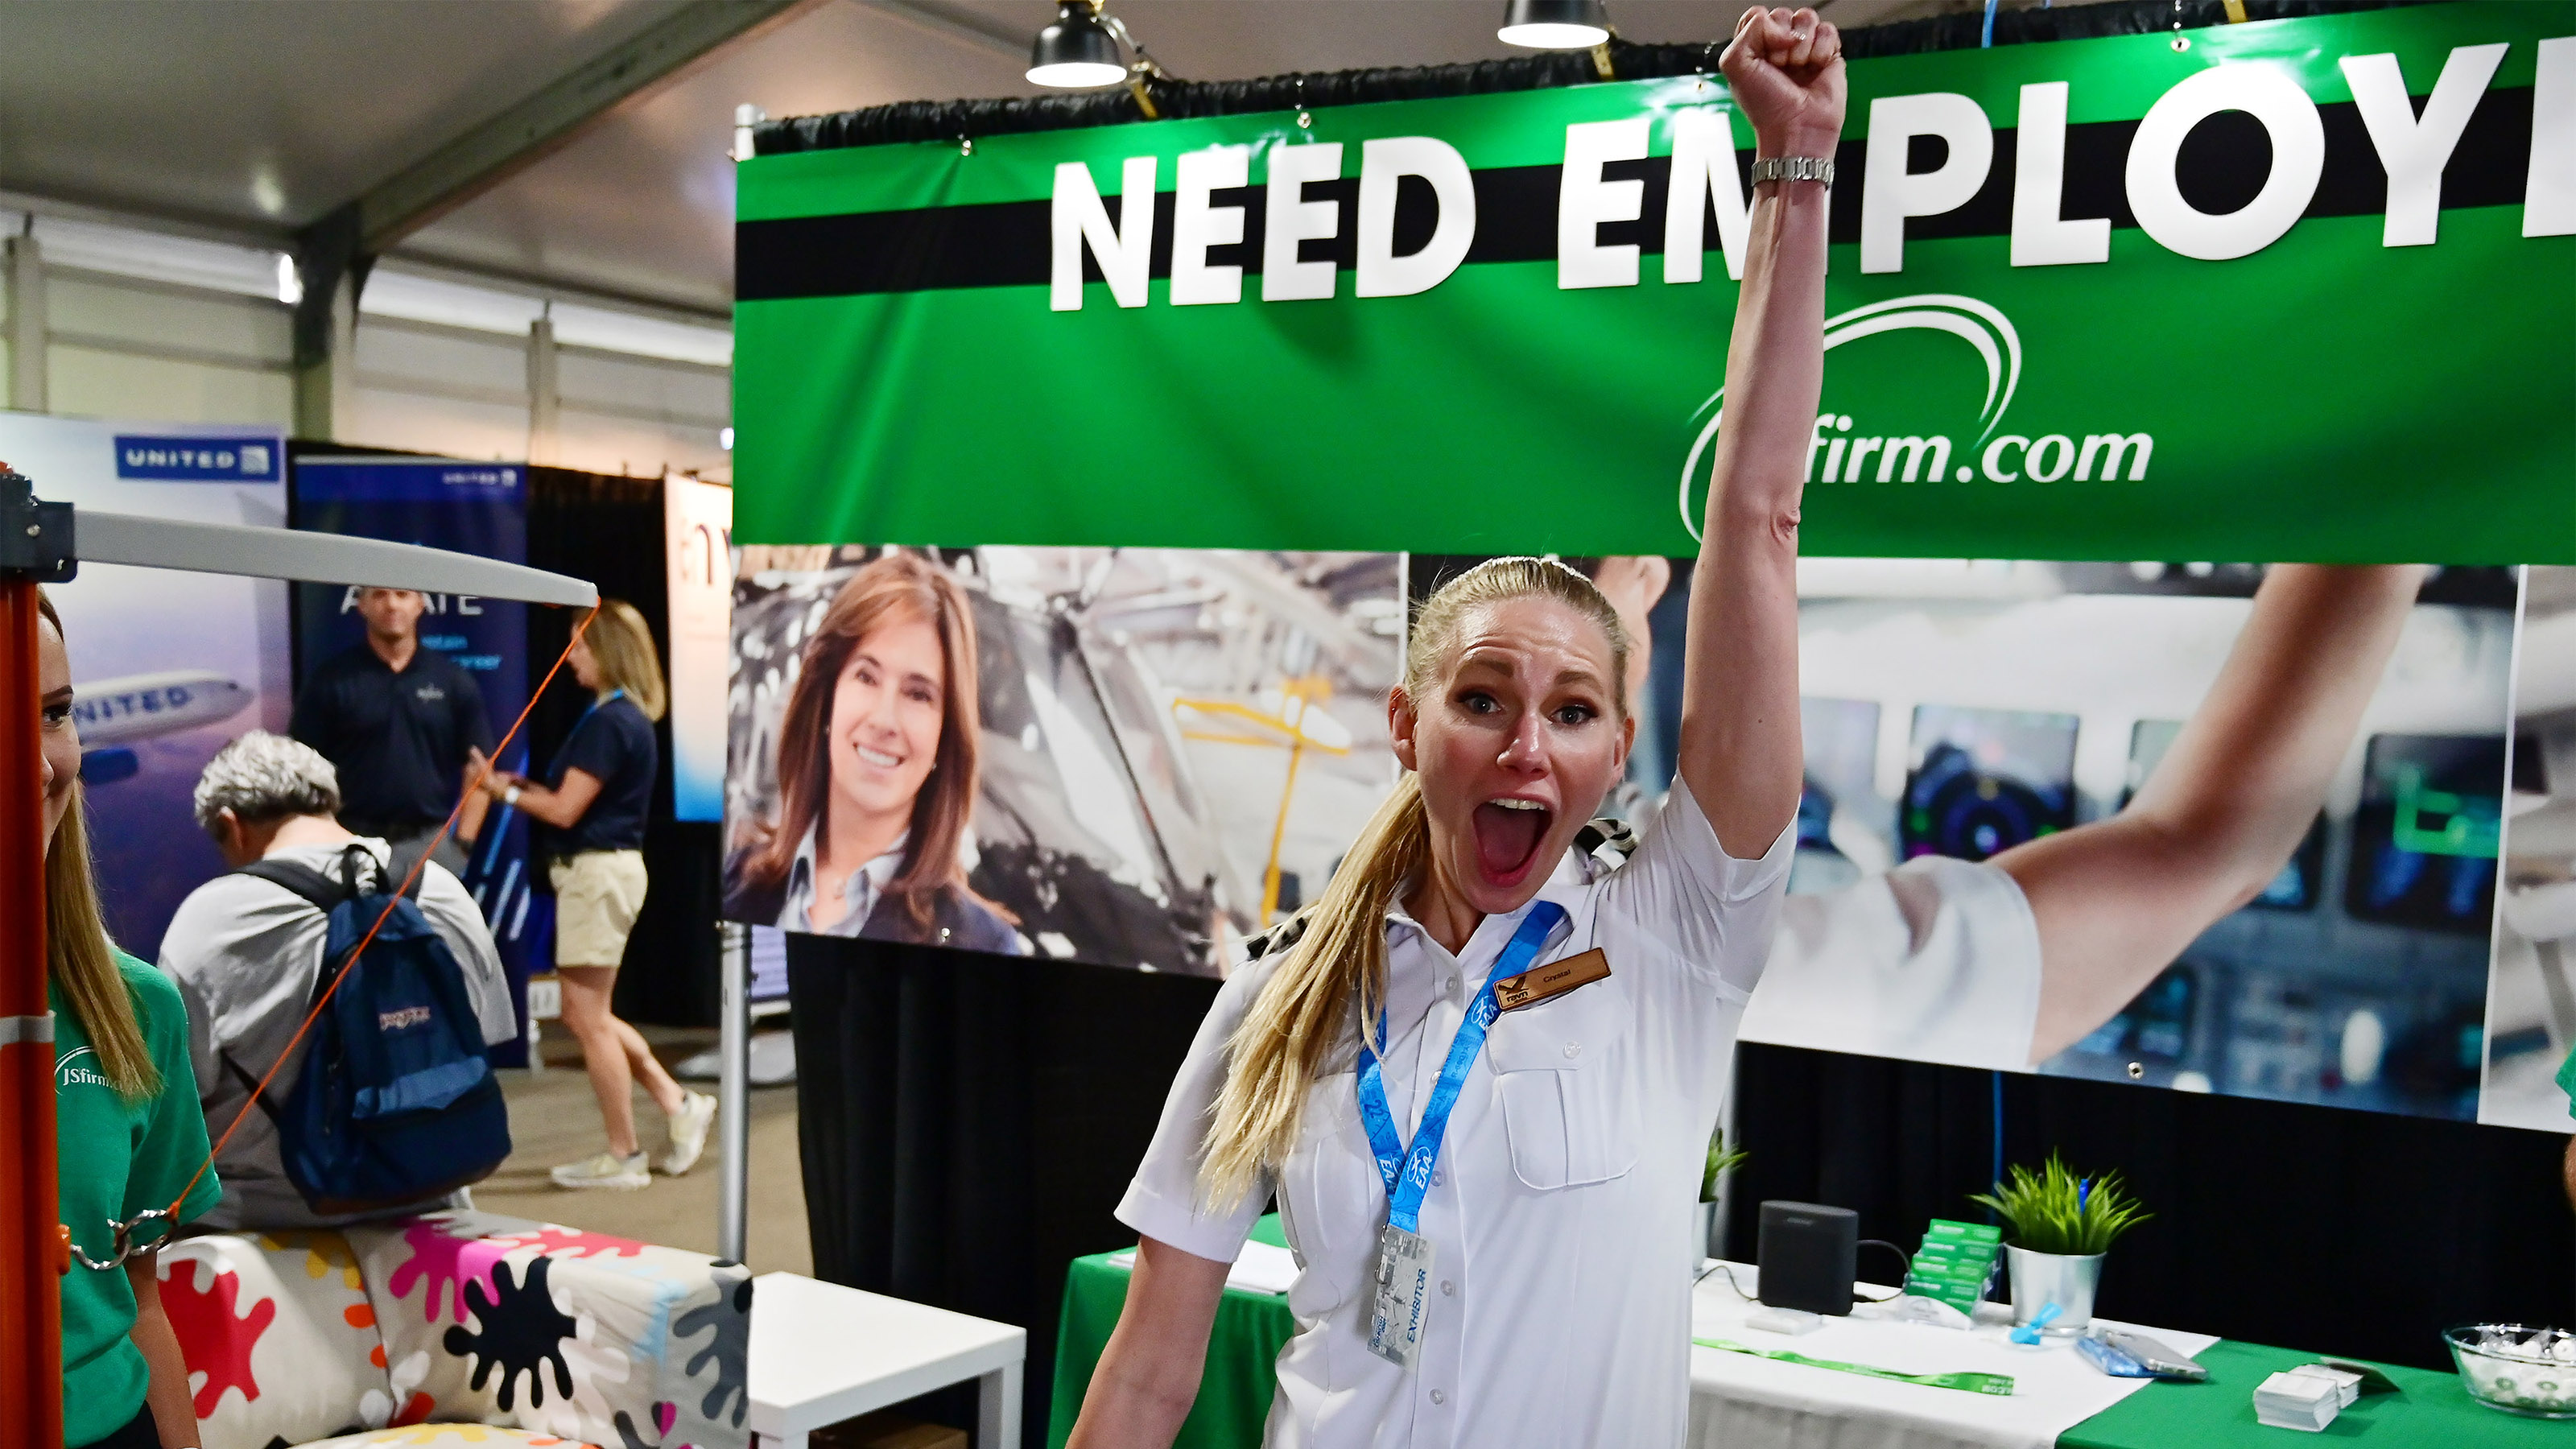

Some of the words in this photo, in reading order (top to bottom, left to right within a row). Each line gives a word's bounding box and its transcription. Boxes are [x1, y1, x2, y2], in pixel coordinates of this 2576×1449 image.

[1050, 135, 1477, 311] NEED
[126, 448, 236, 469] UNITED
[1803, 412, 2154, 483] firm.com
[74, 686, 188, 723] NITED
[1543, 969, 1571, 983] Crystal
[1506, 991, 1529, 1002] ravn
[1478, 1003, 1498, 1031] EAA
[63, 1068, 112, 1088] JSfirm
[1415, 1155, 1433, 1190] EAA
[1407, 1268, 1427, 1344] EXHIBITOR
